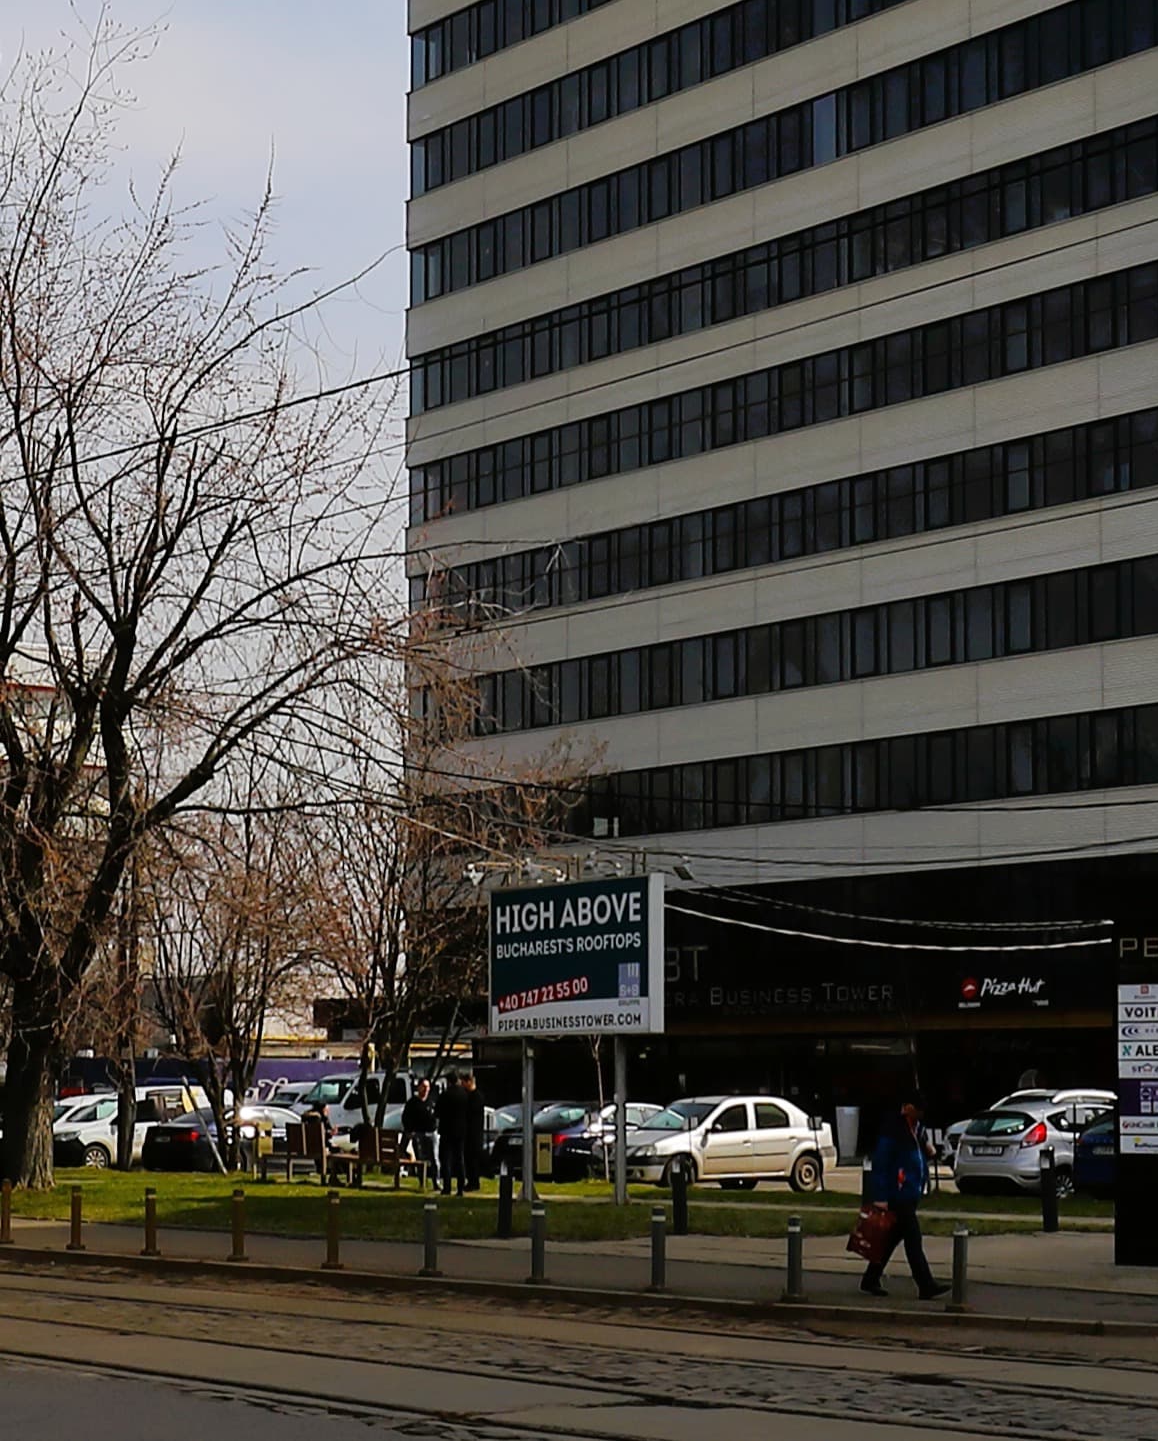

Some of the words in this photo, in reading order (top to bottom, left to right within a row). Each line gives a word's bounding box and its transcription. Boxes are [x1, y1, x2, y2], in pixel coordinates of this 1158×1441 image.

[496, 900, 554, 935] HIGH
[560, 891, 641, 929] ABOVE
[496, 937, 574, 959] BUCHAREST'S
[576, 932, 641, 951] ROOFTOPS
[499, 995, 518, 1010] +40
[521, 988, 538, 1006] 747
[542, 985, 554, 1000] 22
[556, 982, 569, 997] 55
[573, 977, 589, 993] 00
[979, 976, 1016, 997] Pizza
[1017, 976, 1045, 995] Hut
[498, 1013, 641, 1032] PIPERABUSINESSTOWER.COM
